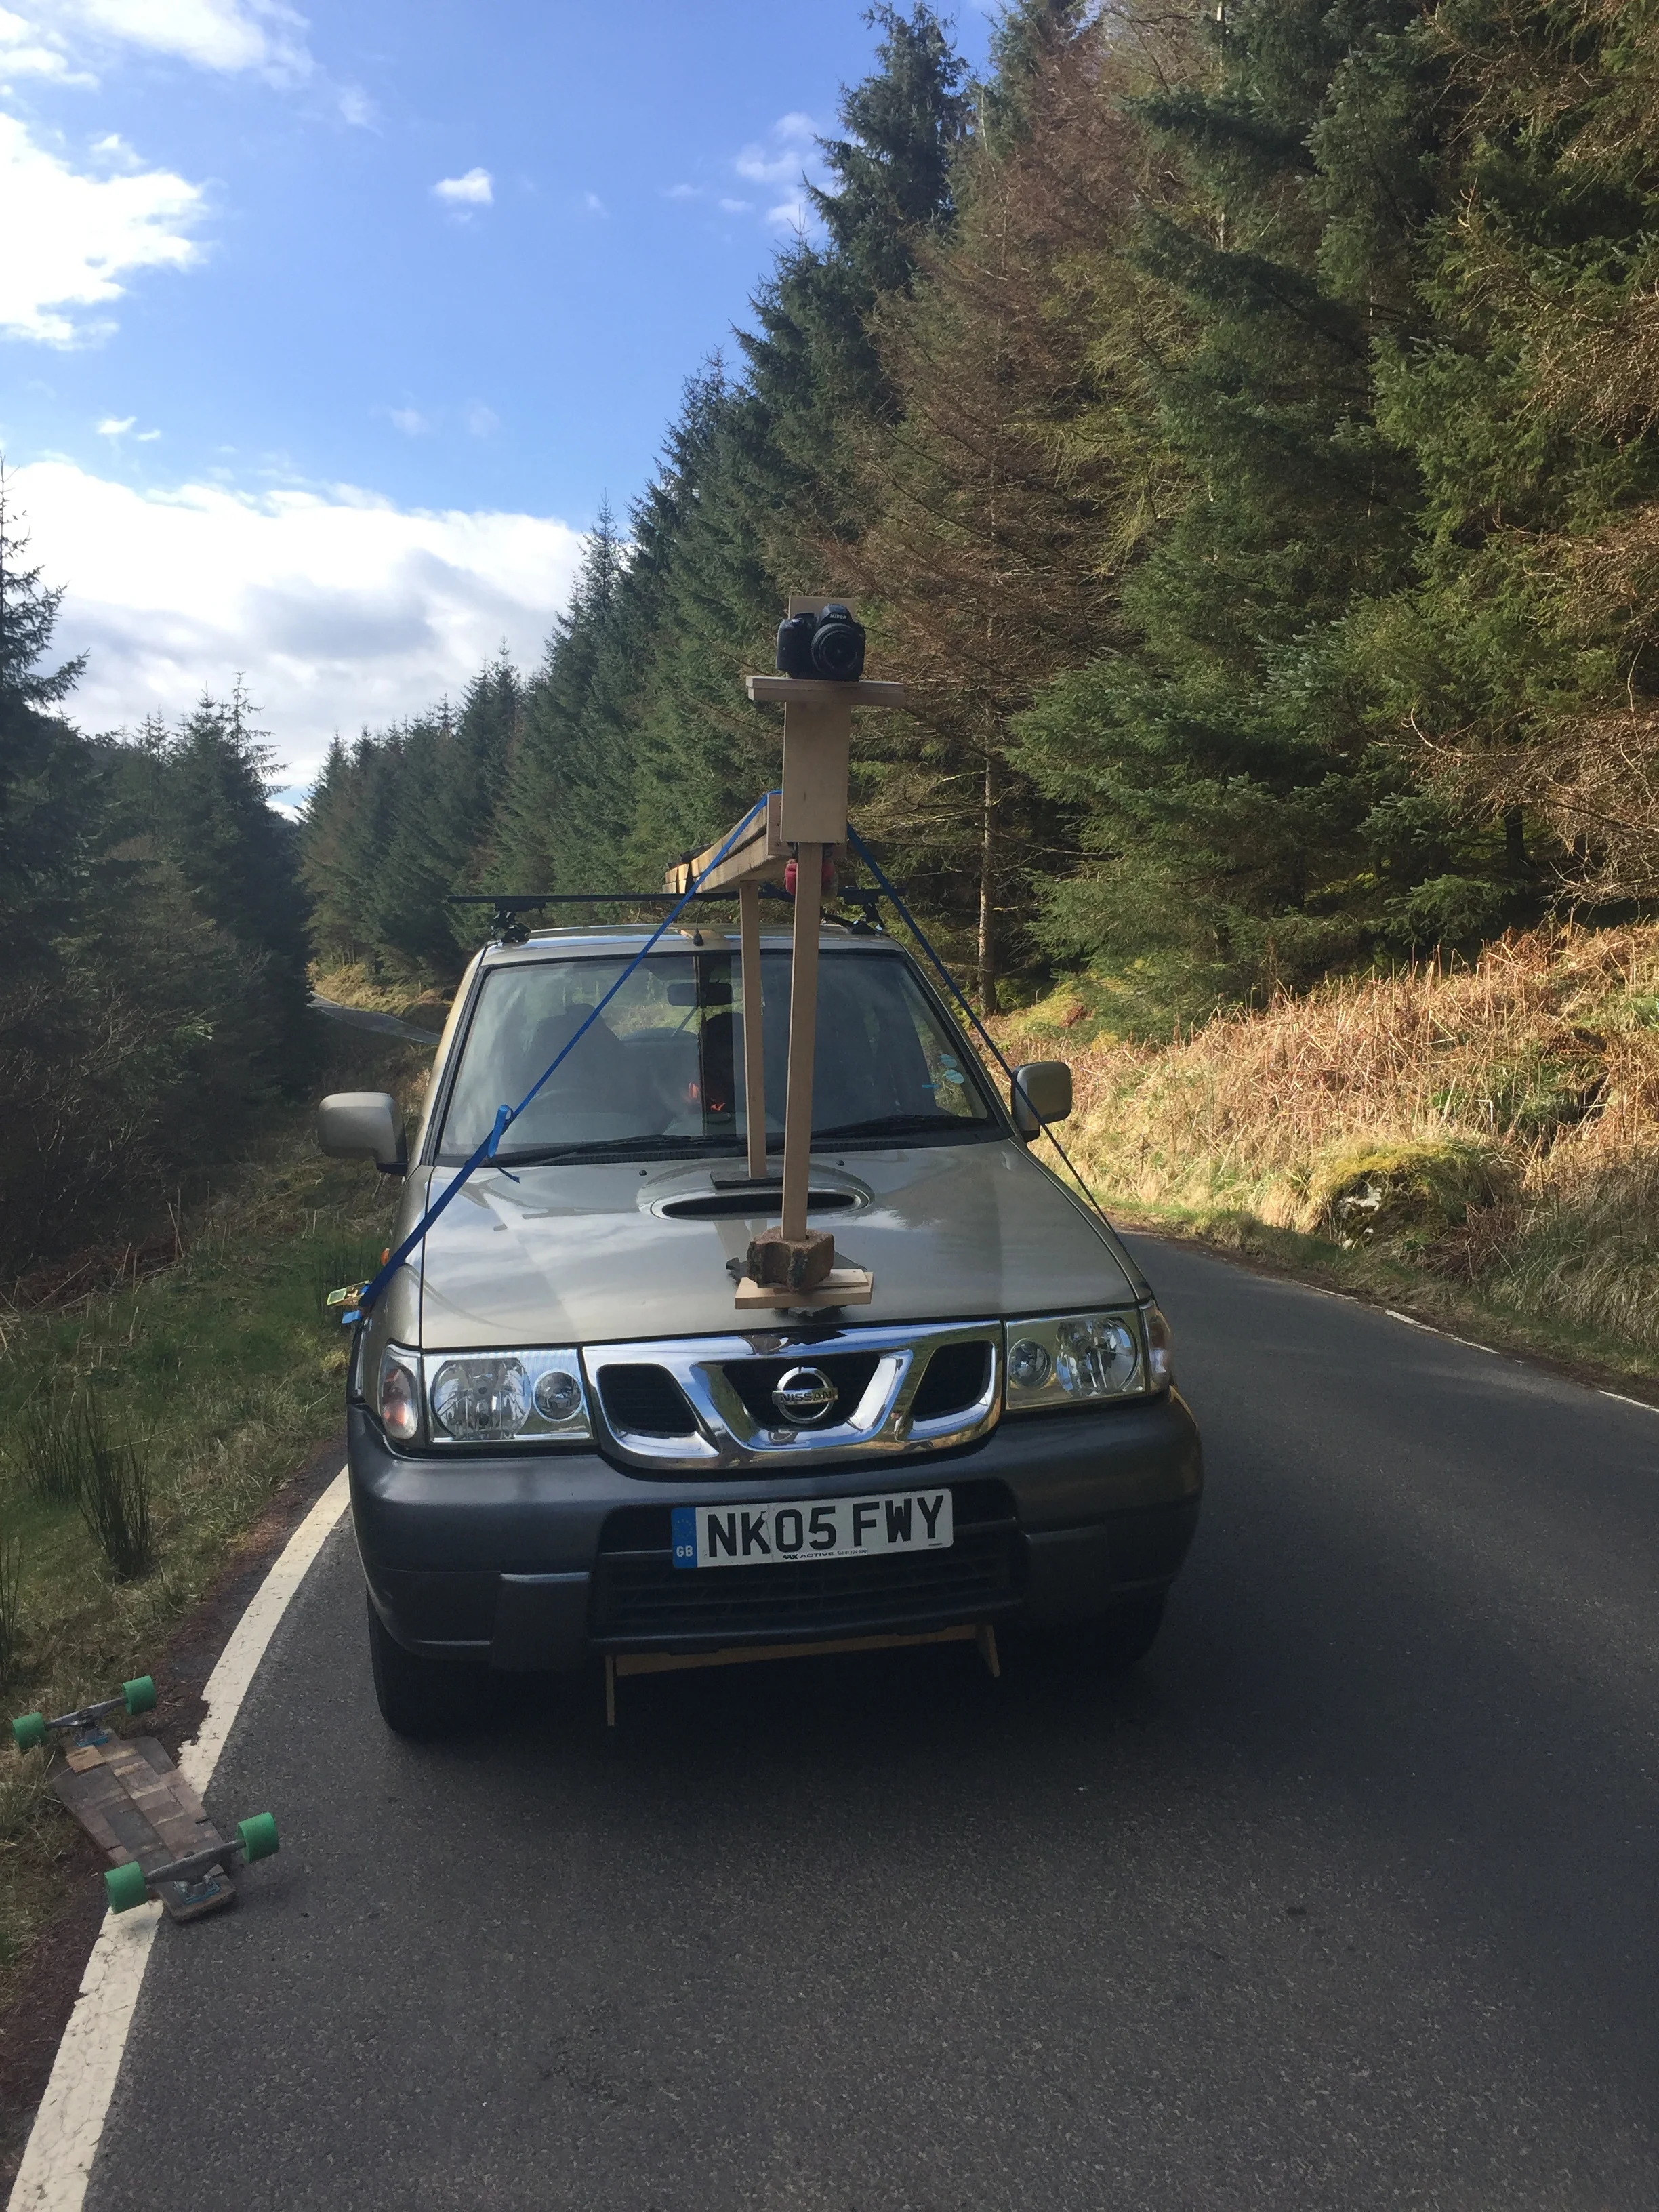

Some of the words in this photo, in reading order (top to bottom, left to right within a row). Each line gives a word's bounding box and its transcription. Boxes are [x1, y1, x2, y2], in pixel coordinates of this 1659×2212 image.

[780, 1391, 832, 1401] NISSAN
[708, 1505, 837, 1557] NK05
[853, 1495, 944, 1547] FWY
[676, 1545, 693, 1557] GB
